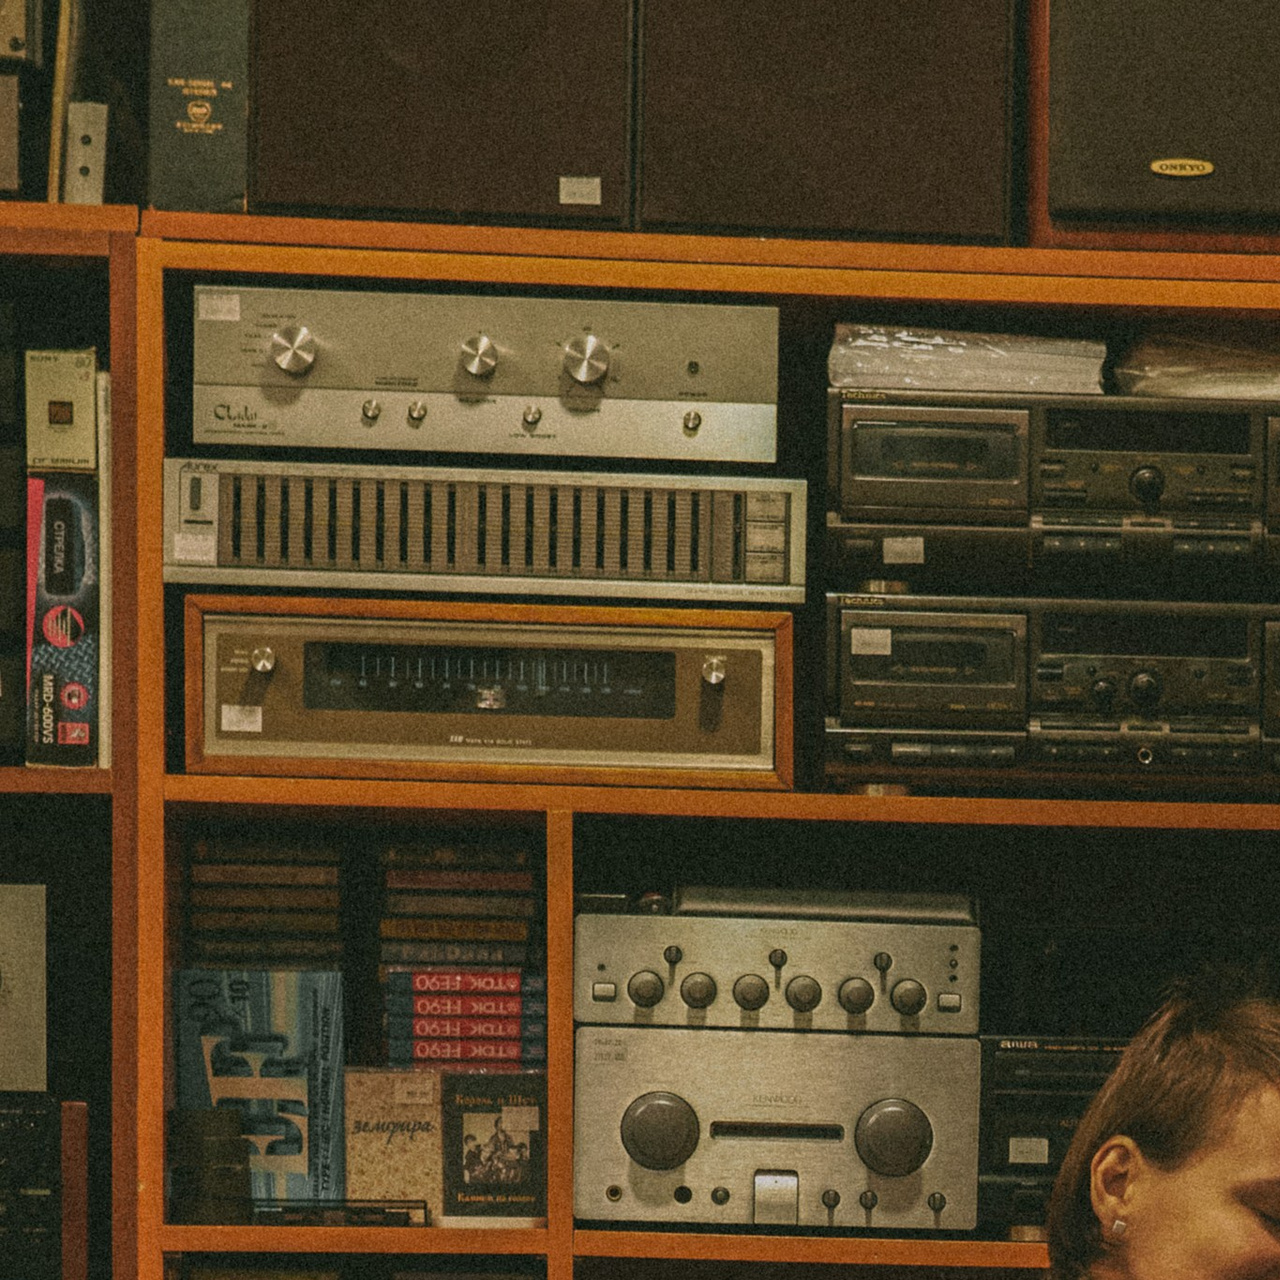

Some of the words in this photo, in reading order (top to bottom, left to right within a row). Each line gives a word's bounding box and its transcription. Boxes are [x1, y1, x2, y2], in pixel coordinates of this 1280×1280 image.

[1159, 163, 1206, 172] ONKYO
[53, 520, 65, 574] СТРЕЛКА
[415, 975, 462, 990] FE90
[470, 975, 508, 989] TDK
[415, 999, 462, 1015] FE90
[470, 999, 508, 1014] TDK
[415, 1020, 462, 1036] FE90
[470, 1020, 508, 1035] TDK
[415, 1043, 462, 1058] FE90
[470, 1043, 508, 1057] TDK
[1000, 1040, 1039, 1049] aiwa
